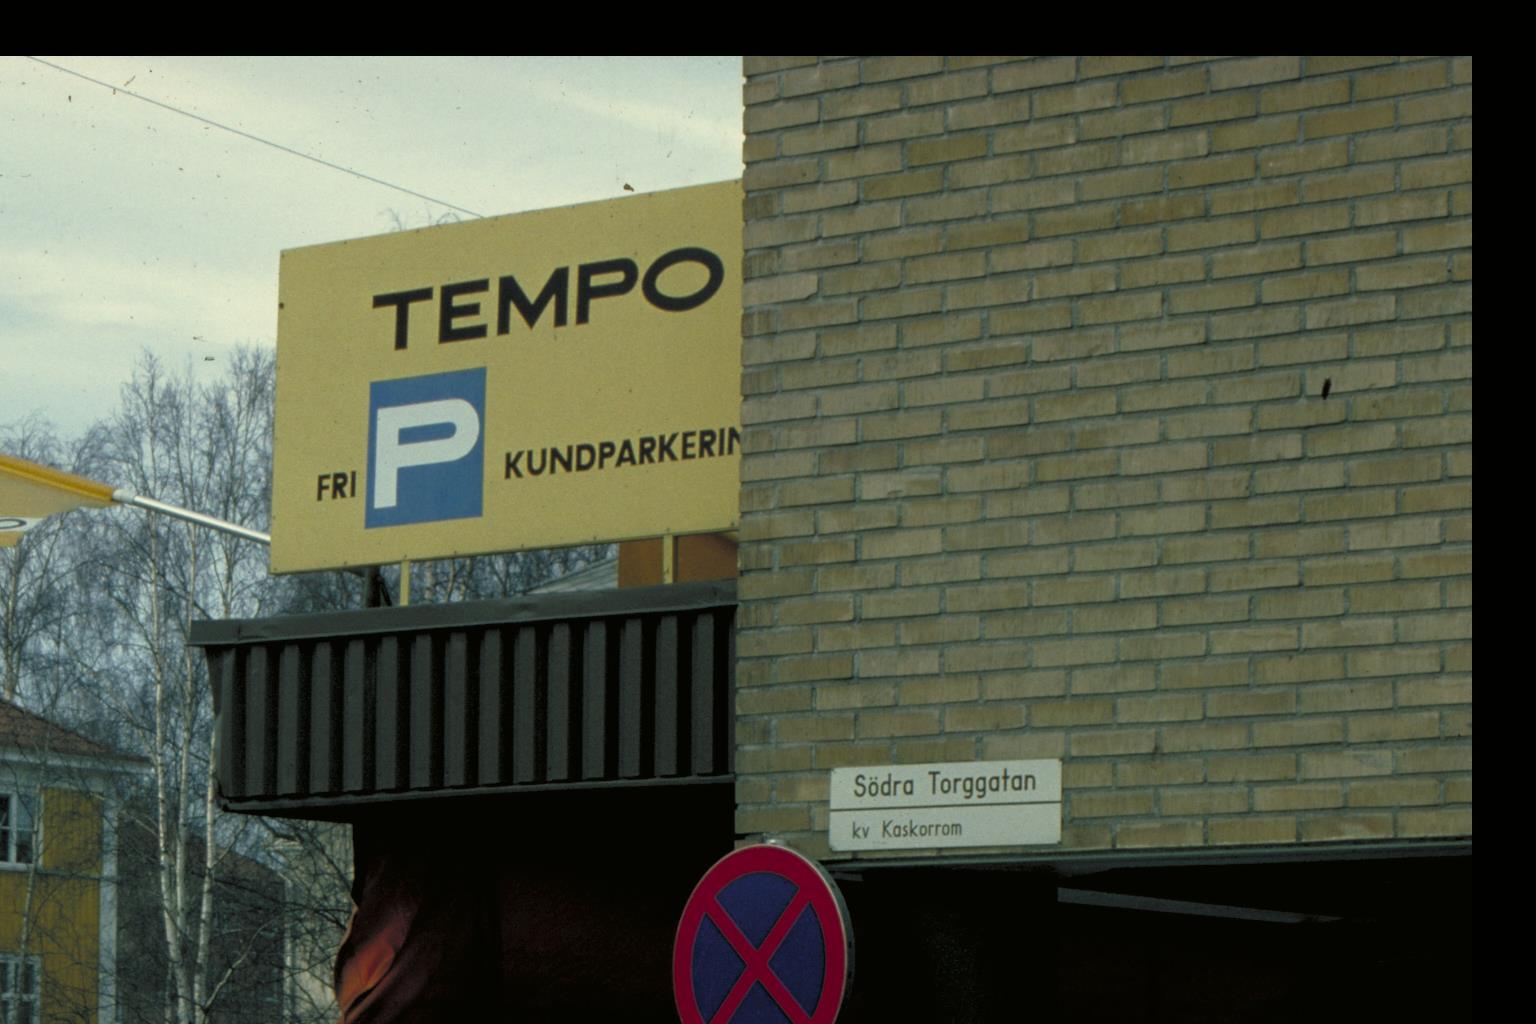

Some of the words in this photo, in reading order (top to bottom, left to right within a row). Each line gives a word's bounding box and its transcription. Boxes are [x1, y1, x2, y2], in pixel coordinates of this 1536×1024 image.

[372, 246, 725, 351] TEMPO
[316, 470, 356, 502] FRI
[373, 398, 481, 510] P
[853, 773, 914, 798] Södra
[928, 768, 1036, 799] Torggatan
[852, 821, 870, 839] kv
[882, 819, 962, 838] Kaskorrom
